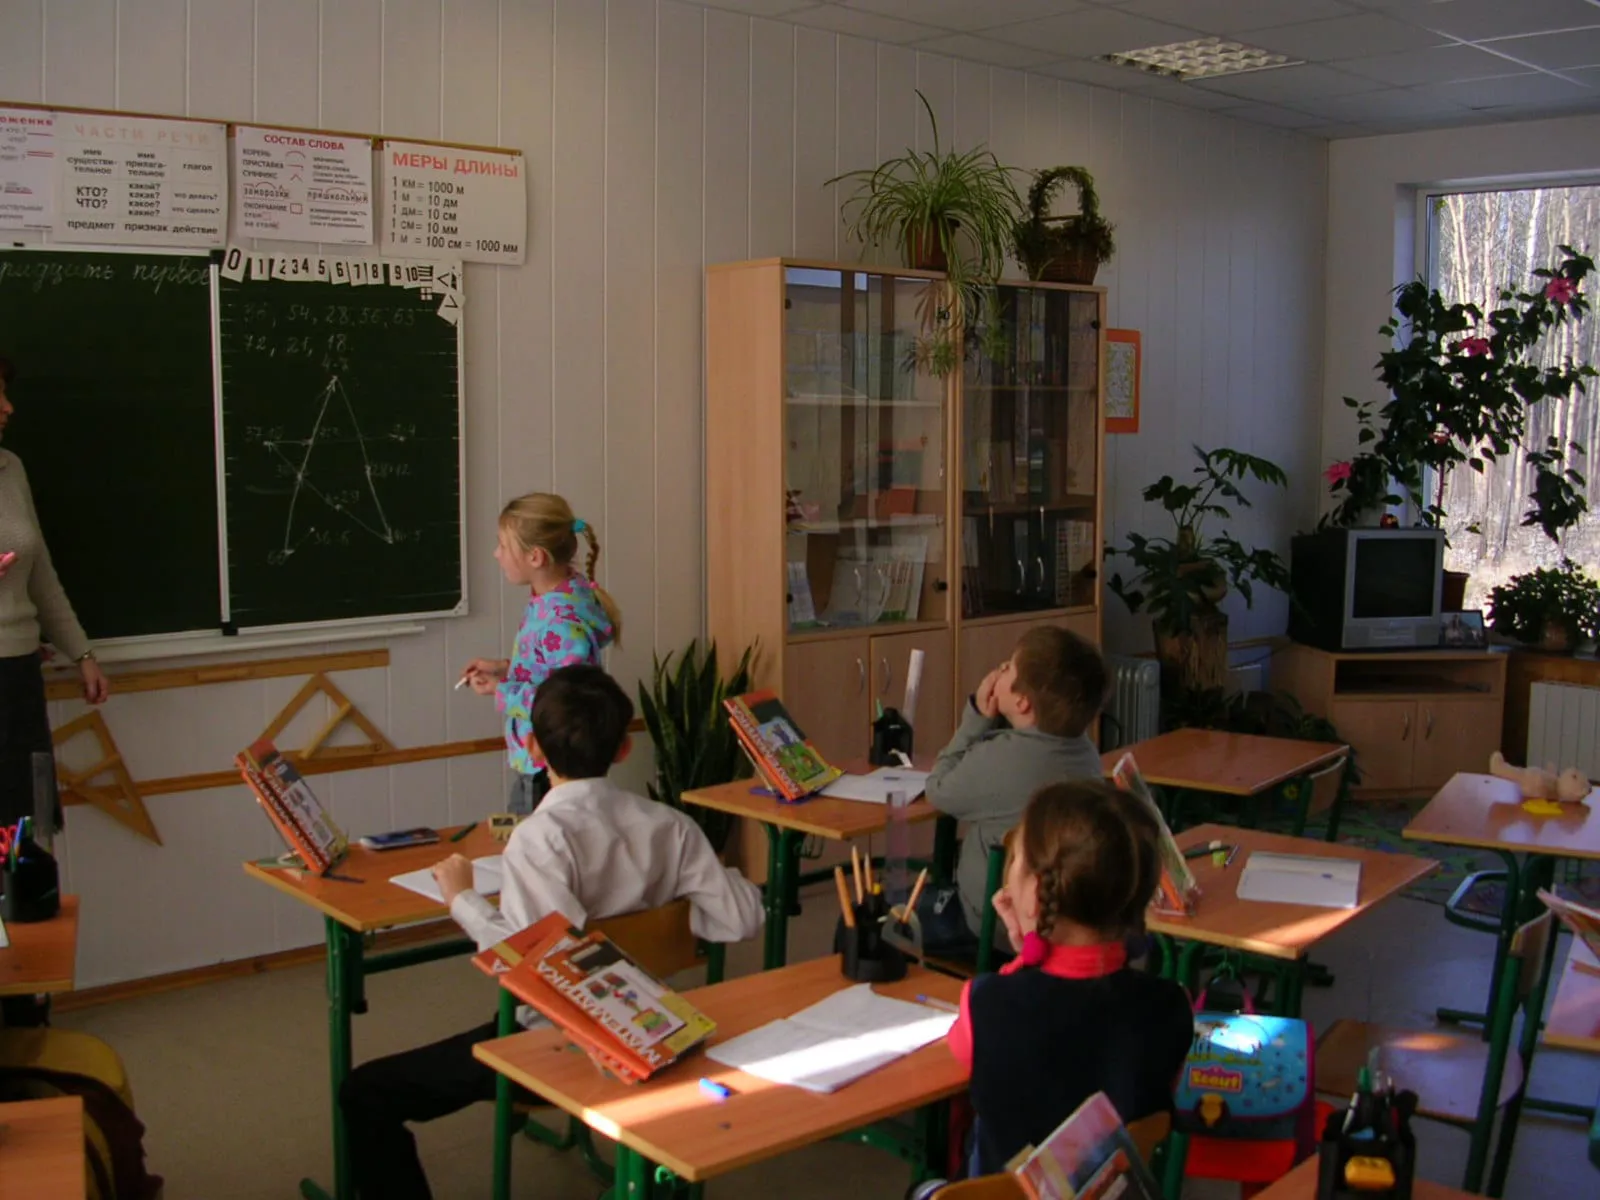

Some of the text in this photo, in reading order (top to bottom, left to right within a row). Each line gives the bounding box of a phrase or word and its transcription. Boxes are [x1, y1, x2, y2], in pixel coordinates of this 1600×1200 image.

[75, 124, 209, 144] ЧАСТИ РЕЧИ
[264, 134, 344, 150] СОСТАВ СЛОВА
[74, 166, 112, 175] тельное
[183, 163, 212, 172] глагол
[242, 160, 284, 169] ПРИСТАВКА
[393, 152, 518, 178] МЕРЫ ДЛИНЫ
[128, 169, 164, 178] тельное
[76, 186, 108, 198] КТО?
[428, 181, 454, 194] 1000
[76, 199, 108, 209] ЧТО?
[129, 200, 160, 209] какое?
[428, 195, 440, 207] 10
[428, 209, 440, 220] 10
[67, 219, 115, 231] предмет
[124, 222, 168, 234] признак
[172, 223, 218, 236] действие
[427, 222, 439, 234] 10
[427, 236, 445, 248] 100
[476, 240, 500, 252] 1000
[227, 248, 241, 270] 0
[258, 258, 264, 274] 1
[280, 259, 286, 274] 2
[292, 258, 298, 275] 3
[302, 258, 309, 273] 4
[318, 260, 325, 275] 5
[336, 262, 344, 277] 6
[353, 264, 361, 279] 7
[372, 264, 378, 278] 8
[395, 265, 401, 280] 9
[406, 267, 418, 282] 10
[536, 959, 662, 1066] МАТЕМАТИКА
